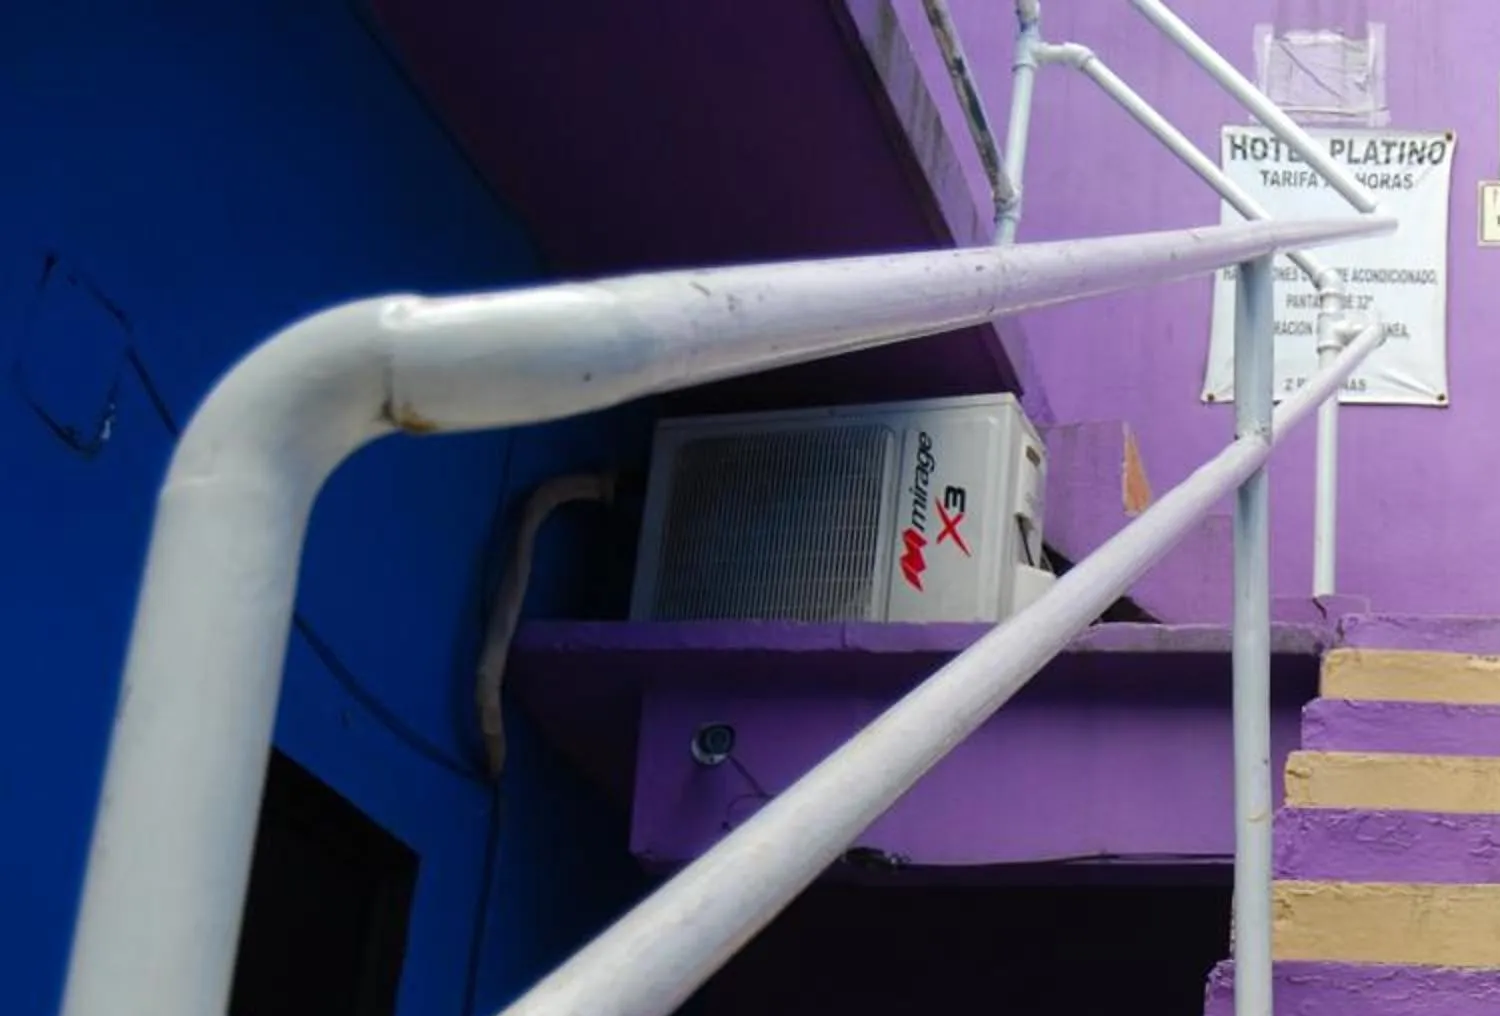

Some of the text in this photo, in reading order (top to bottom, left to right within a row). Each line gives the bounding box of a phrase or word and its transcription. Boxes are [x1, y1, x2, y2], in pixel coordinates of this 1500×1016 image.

[1229, 134, 1446, 166] HOTE PLATINO
[1259, 169, 1318, 188] TARIFA
[909, 431, 936, 532] mirage
[936, 485, 972, 558] X3
